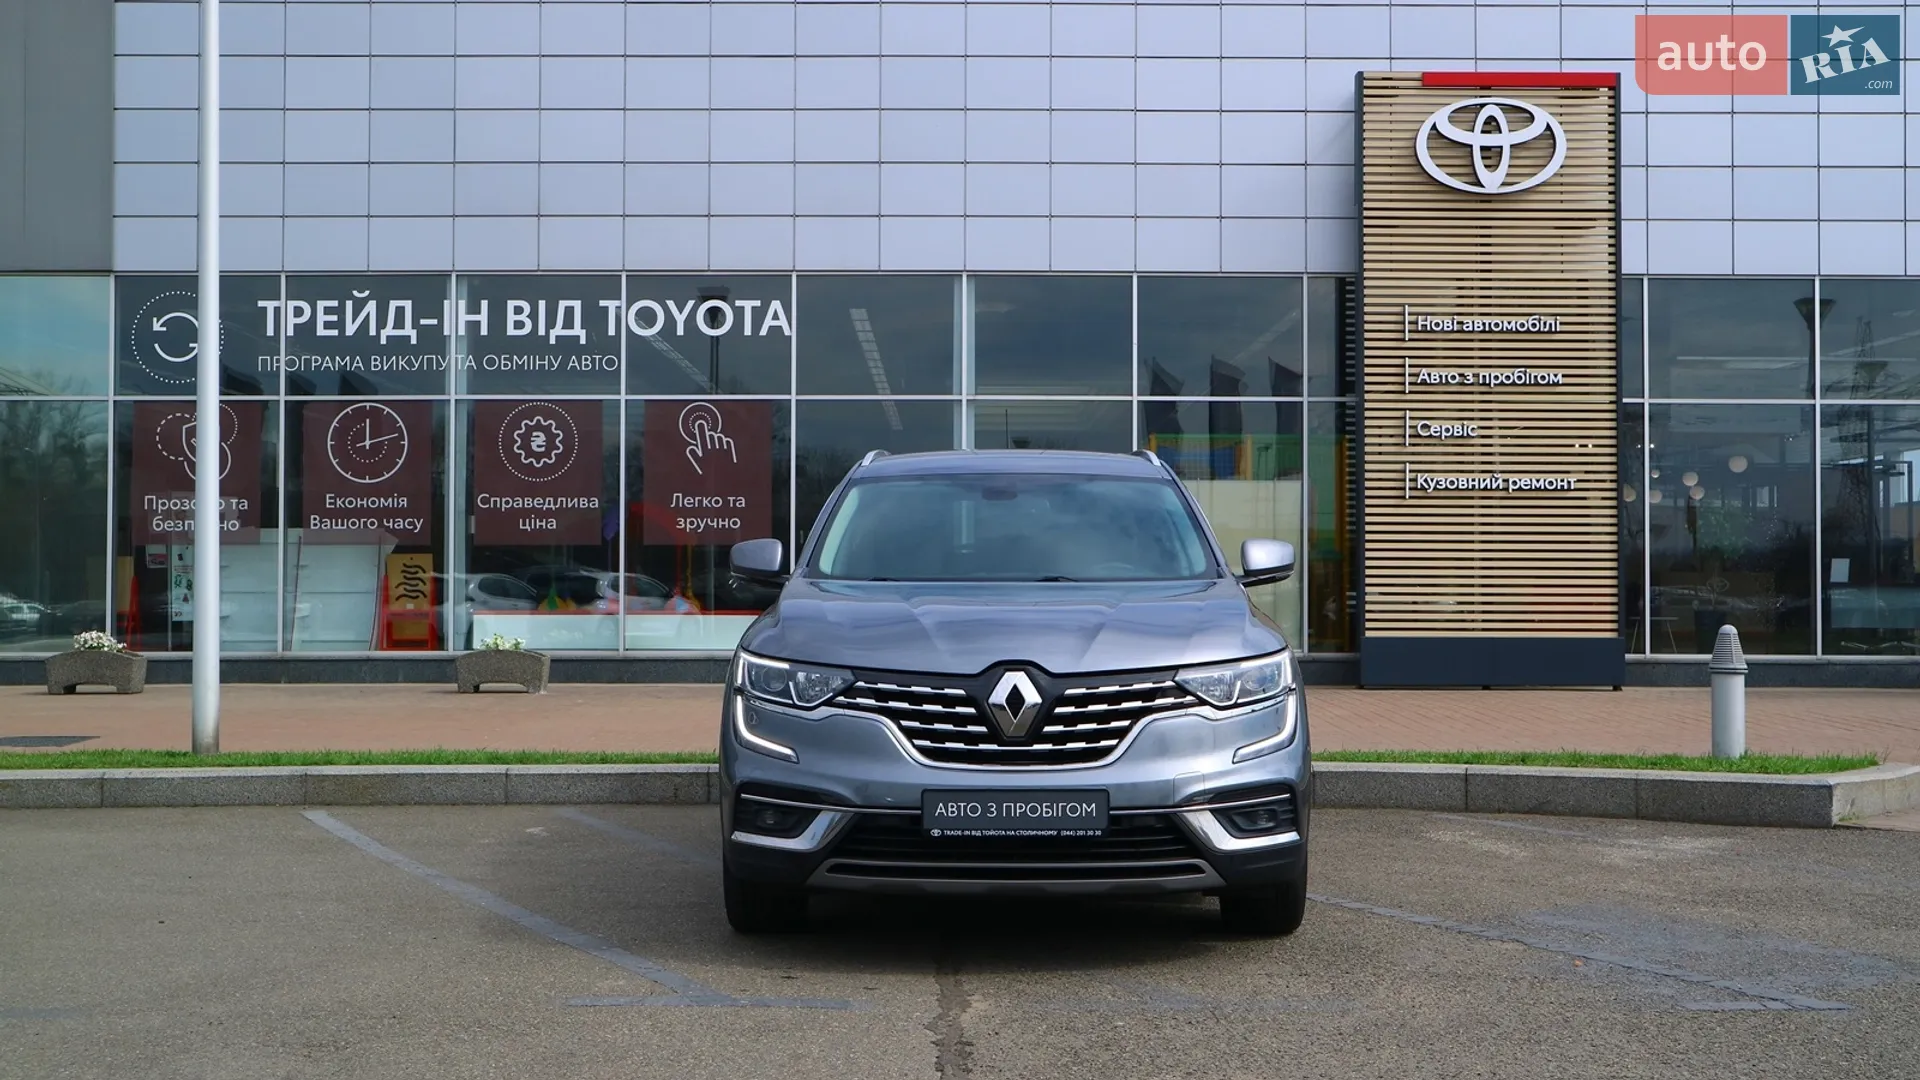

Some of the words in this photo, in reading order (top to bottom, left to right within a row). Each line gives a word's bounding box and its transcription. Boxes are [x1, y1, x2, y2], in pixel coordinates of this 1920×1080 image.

[257, 290, 489, 344] ТРЕЙД-ІН
[506, 299, 586, 344] ВІД
[599, 299, 792, 336] TOYOTA
[1417, 316, 1458, 331] Нові
[1462, 316, 1561, 332] автомобілі
[258, 355, 365, 372] ПРОГРАМА
[371, 355, 450, 371] ВИКУПУ
[455, 354, 477, 370] ТА
[483, 354, 560, 371] ОБМІНУ
[567, 354, 619, 371] АВТО
[1417, 369, 1459, 384] Авто
[1463, 372, 1474, 384] з
[1479, 368, 1563, 388] пробігом
[1417, 420, 1478, 441] Сервіс
[1417, 473, 1503, 493] Кузовний
[1508, 478, 1577, 493] ремонт
[144, 495, 225, 513] Прозо
[230, 499, 249, 510] та
[325, 493, 407, 508] Економія
[477, 494, 599, 511] Справедлива
[670, 493, 723, 508] Легко
[727, 498, 746, 508] та
[152, 515, 240, 532] безпно
[310, 515, 378, 530] Вашого
[383, 518, 423, 533] часу
[519, 515, 557, 530] ціна
[676, 517, 741, 532] зручно
[934, 803, 982, 817] АВТО
[986, 803, 998, 817] З
[1002, 803, 1096, 818] ПРОБІГОМ
